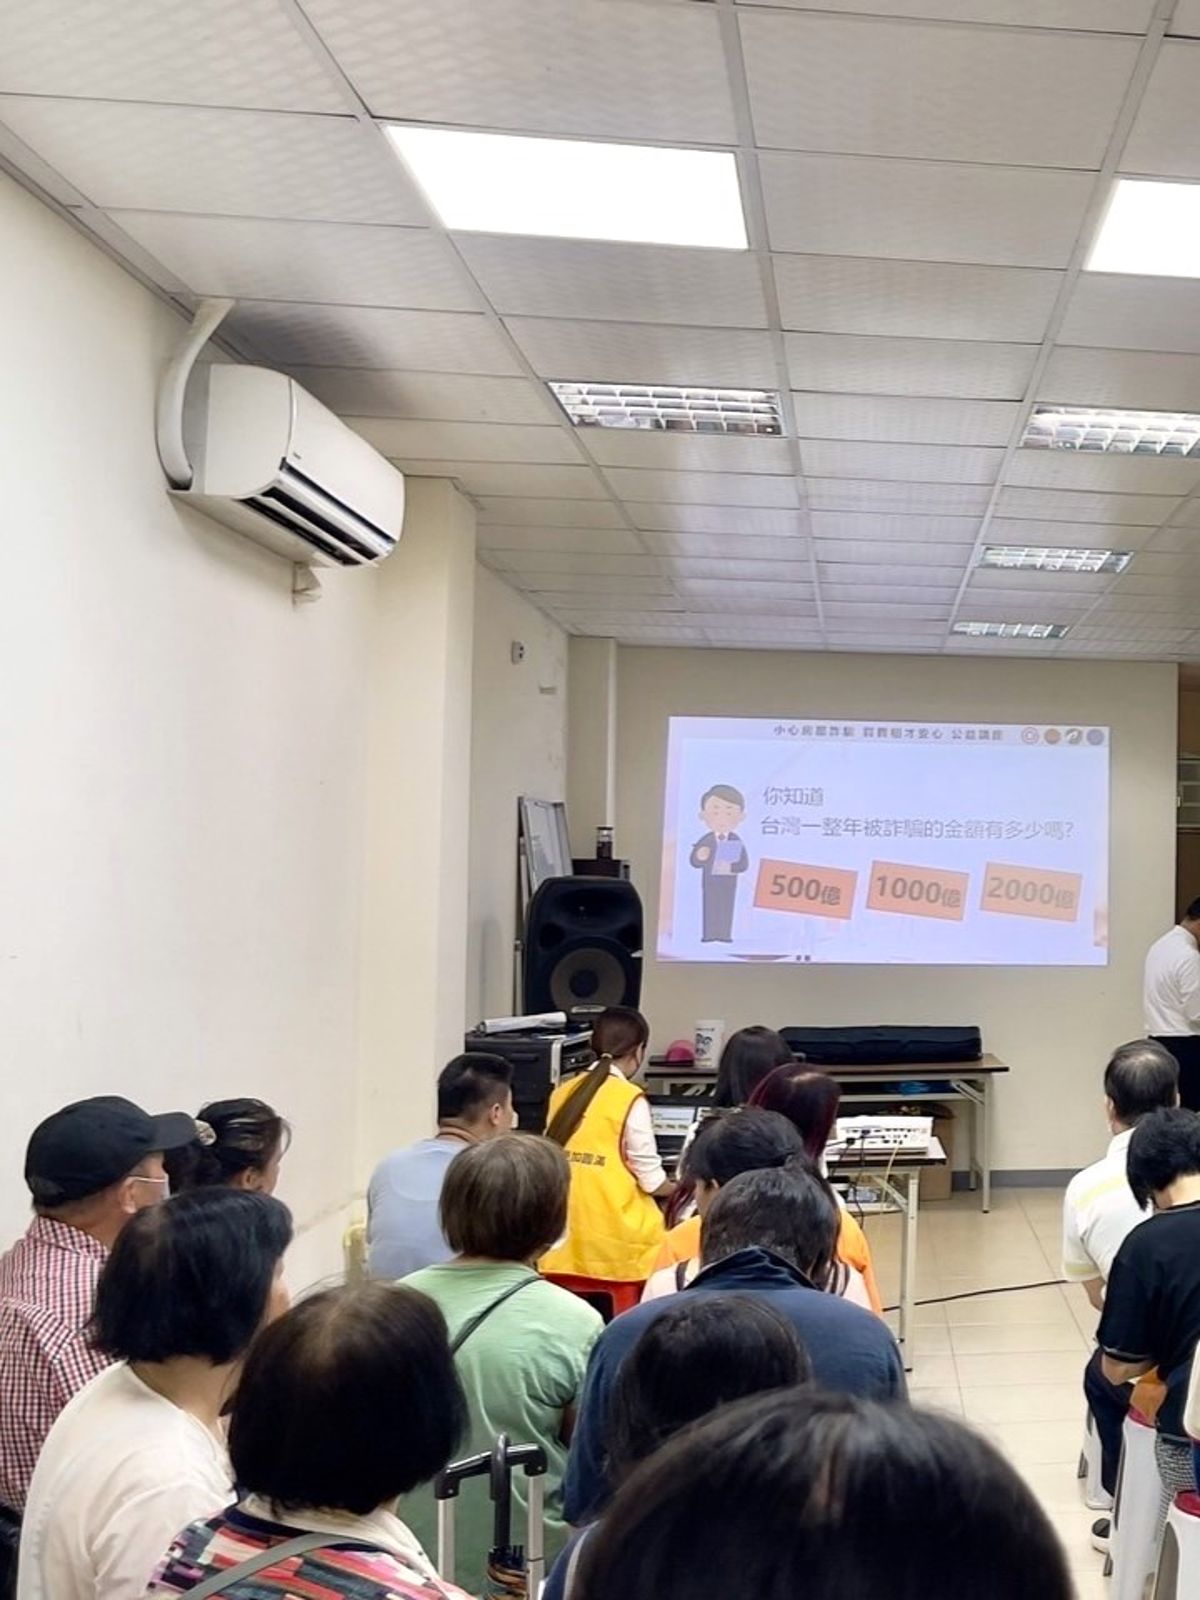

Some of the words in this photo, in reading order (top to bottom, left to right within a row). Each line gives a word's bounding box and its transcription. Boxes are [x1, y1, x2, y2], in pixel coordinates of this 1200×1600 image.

[763, 786, 824, 806] 你知道
[770, 873, 841, 906] 500億
[876, 875, 961, 908] 1000億
[987, 877, 1075, 909] 2000億
